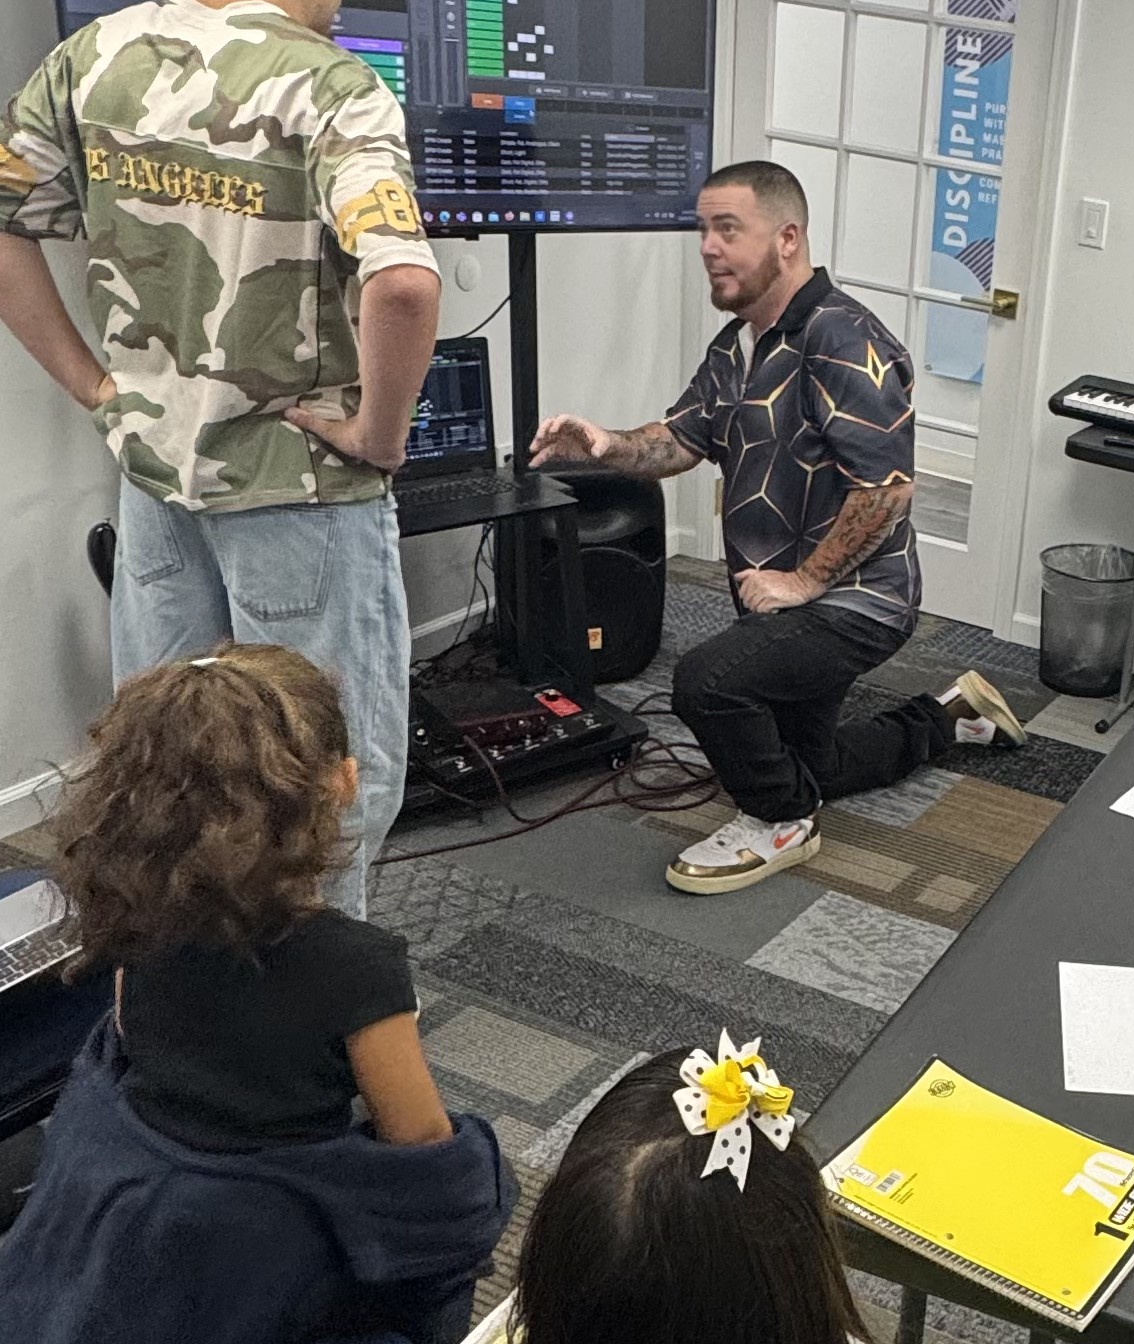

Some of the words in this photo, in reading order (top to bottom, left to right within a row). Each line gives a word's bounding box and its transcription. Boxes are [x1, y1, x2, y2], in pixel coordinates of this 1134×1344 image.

[943, 35, 982, 248] DISCIPLINE
[983, 117, 1006, 132] WIT
[116, 152, 266, 215] ANGELES
[1094, 1221, 1130, 1242] 1
